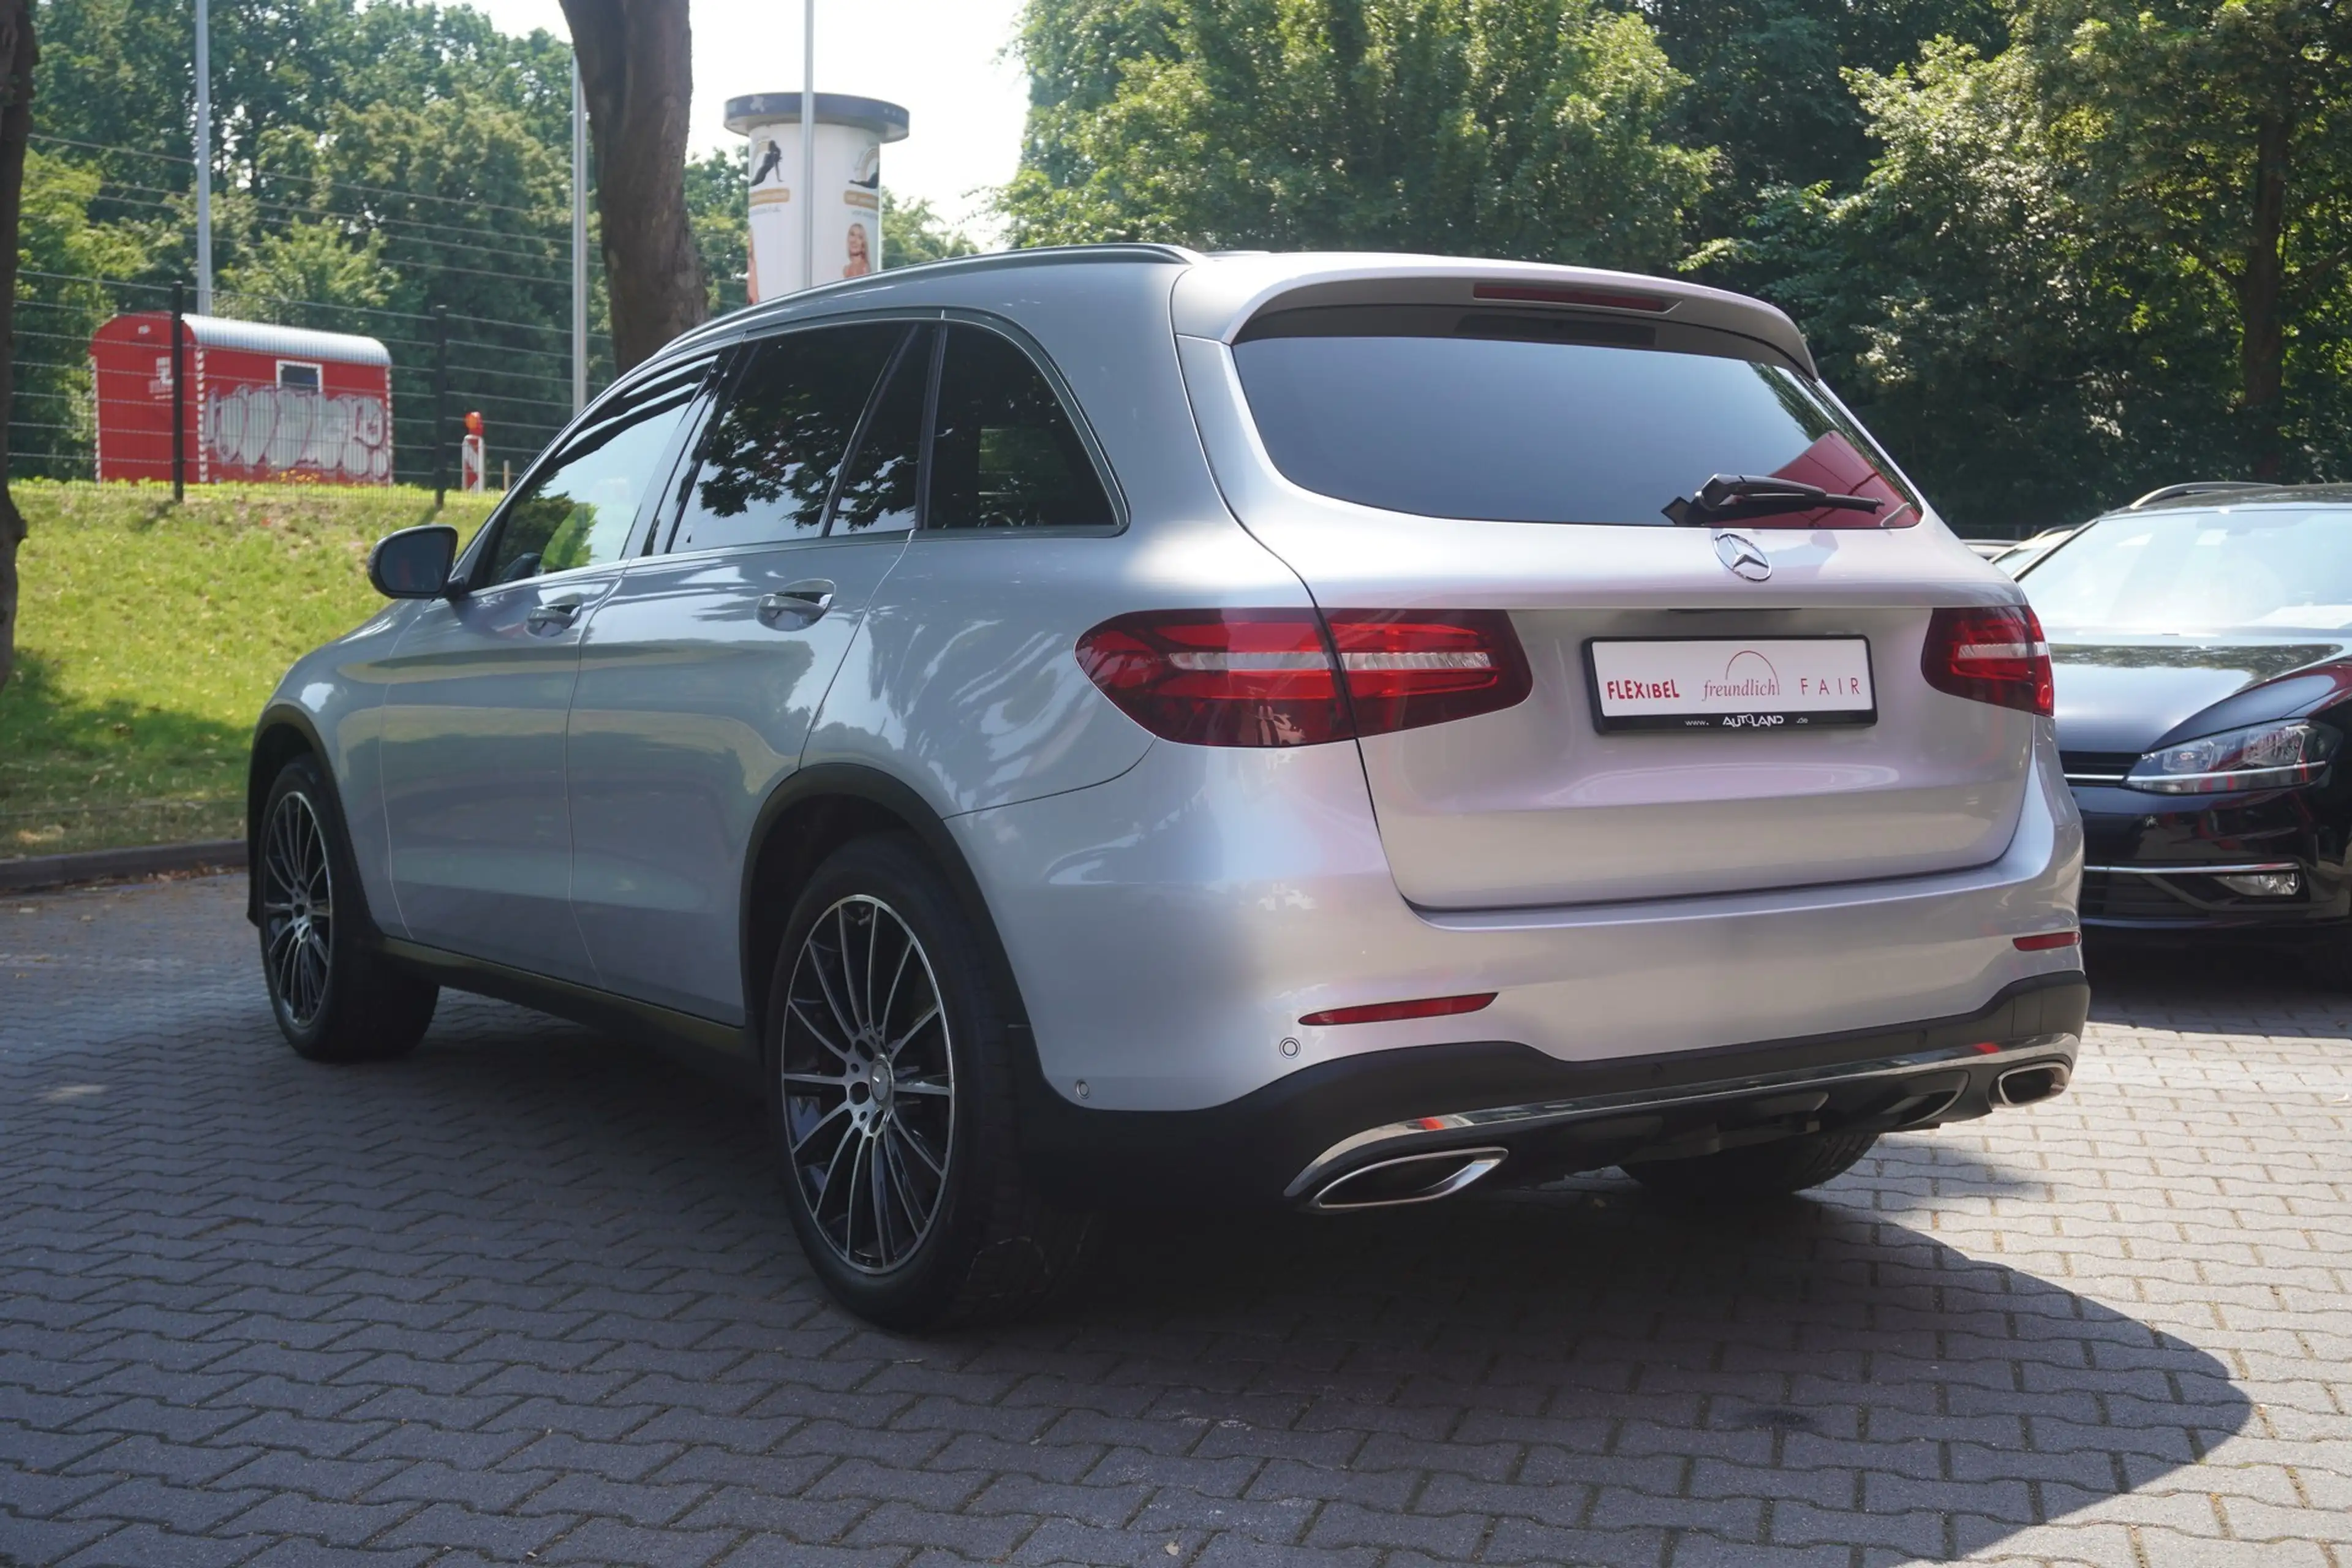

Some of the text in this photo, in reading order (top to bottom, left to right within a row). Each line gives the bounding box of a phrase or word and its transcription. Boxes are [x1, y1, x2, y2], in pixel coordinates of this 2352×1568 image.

[1607, 677, 1861, 701] FLEXIBEL freundlich FAIR
[1722, 713, 1785, 728] AUTOLAND
